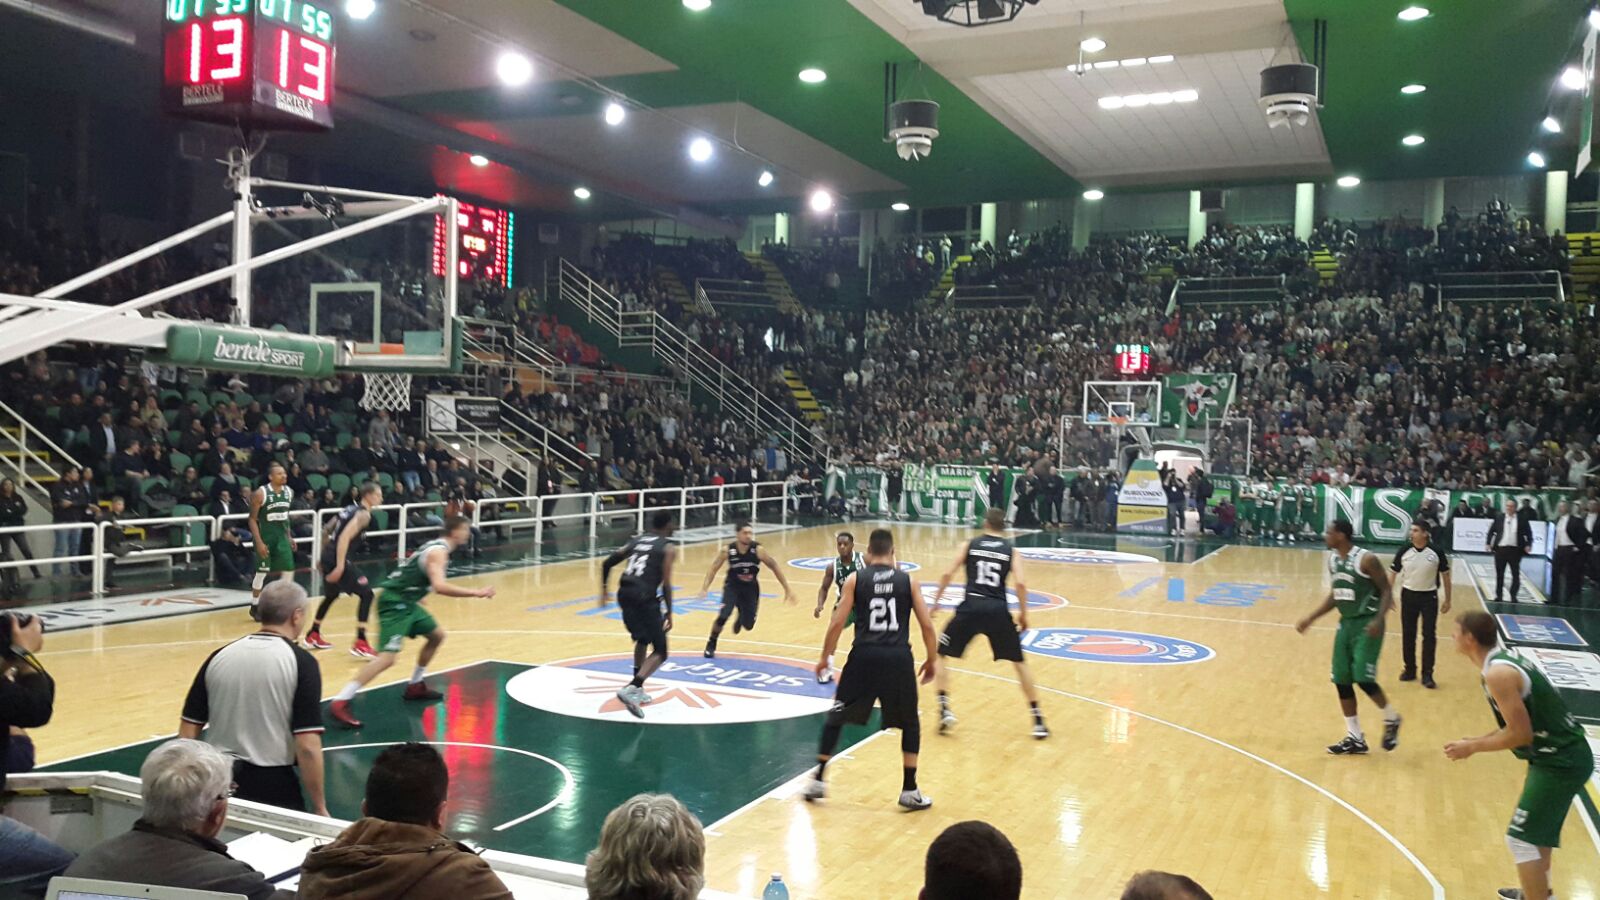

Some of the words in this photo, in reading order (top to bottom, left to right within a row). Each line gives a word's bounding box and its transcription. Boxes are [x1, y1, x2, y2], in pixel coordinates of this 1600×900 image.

[190, 18, 243, 82] 13
[279, 29, 326, 102] 13
[214, 335, 271, 362] bertelè
[271, 353, 305, 367] SPORT
[1121, 352, 1141, 369] 13
[975, 560, 1001, 587] 15
[868, 597, 899, 632] 21
